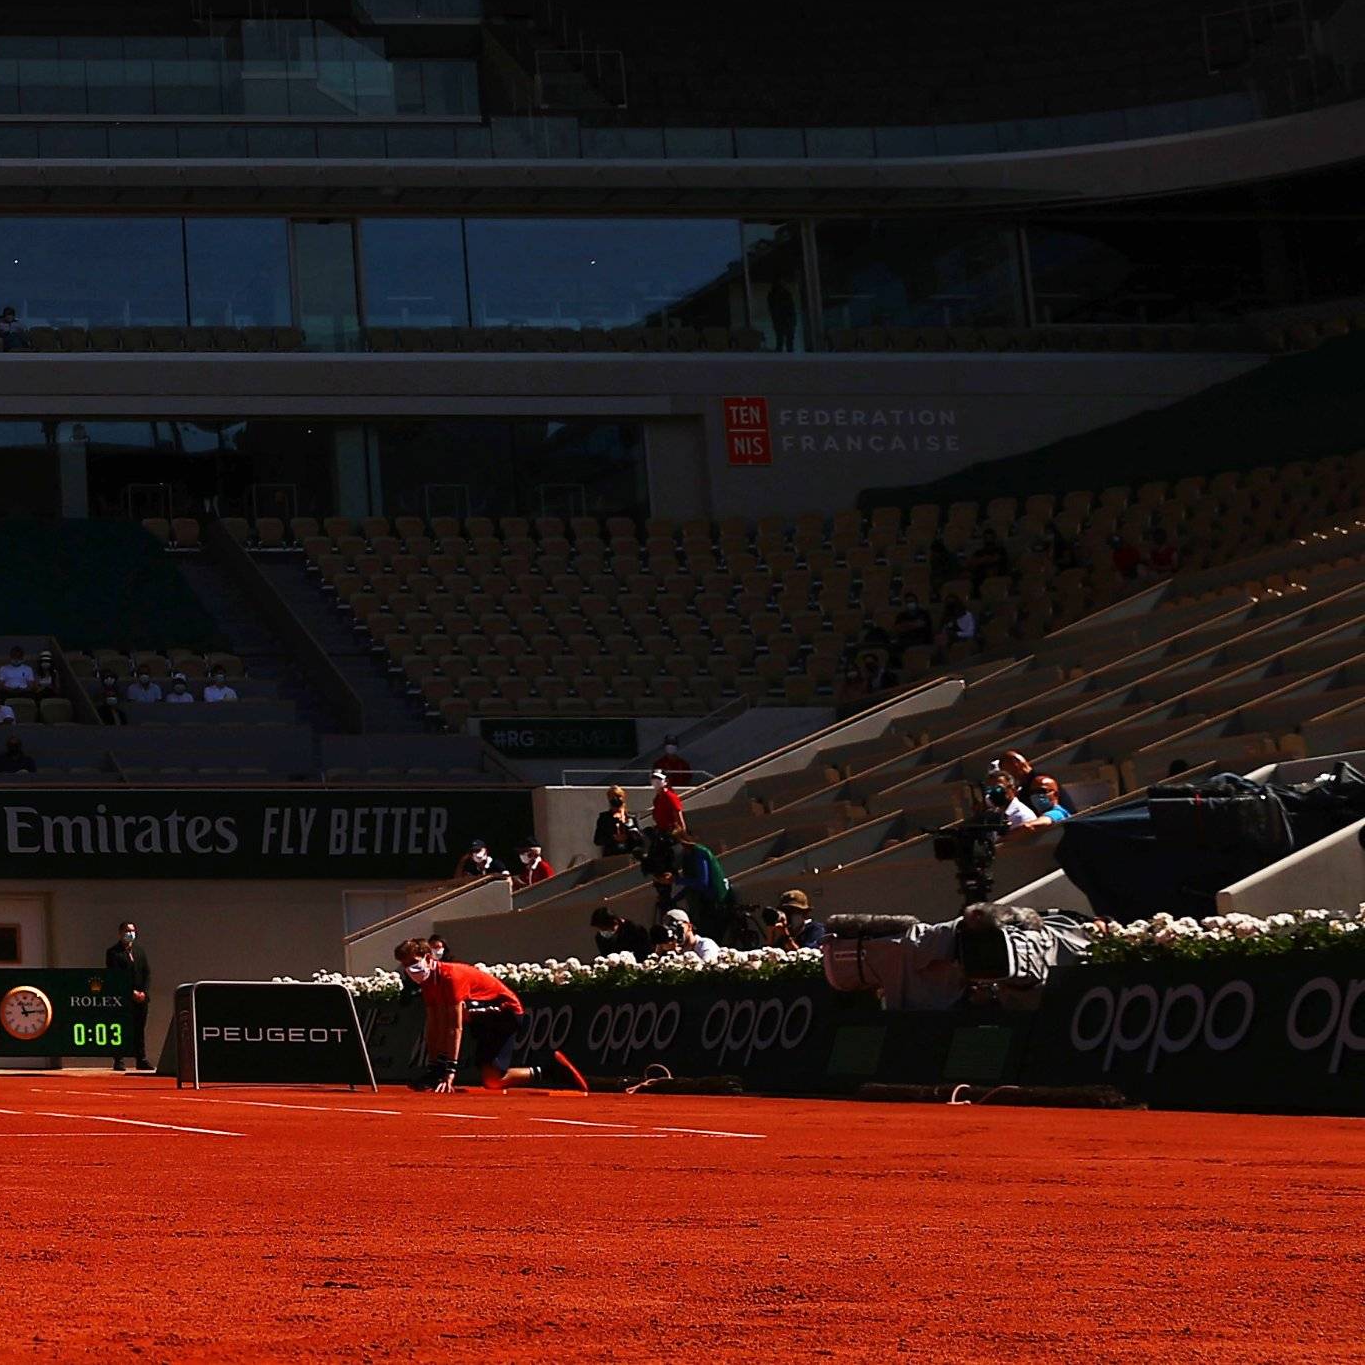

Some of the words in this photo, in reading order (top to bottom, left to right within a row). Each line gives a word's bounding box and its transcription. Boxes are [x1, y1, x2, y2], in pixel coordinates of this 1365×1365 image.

[728, 405, 762, 425] TEN
[733, 434, 764, 456] NIS
[3, 803, 239, 856] Emirates
[261, 806, 317, 856] FLY
[328, 806, 450, 856] BETTER
[70, 996, 123, 1007] ROLEX
[73, 1023, 123, 1046] 0:03
[202, 1027, 349, 1043] PEUGEOT
[588, 1000, 681, 1066] oppo
[701, 996, 813, 1067] oppo
[1071, 979, 1256, 1074] oppo
[1286, 976, 1365, 1074] op
